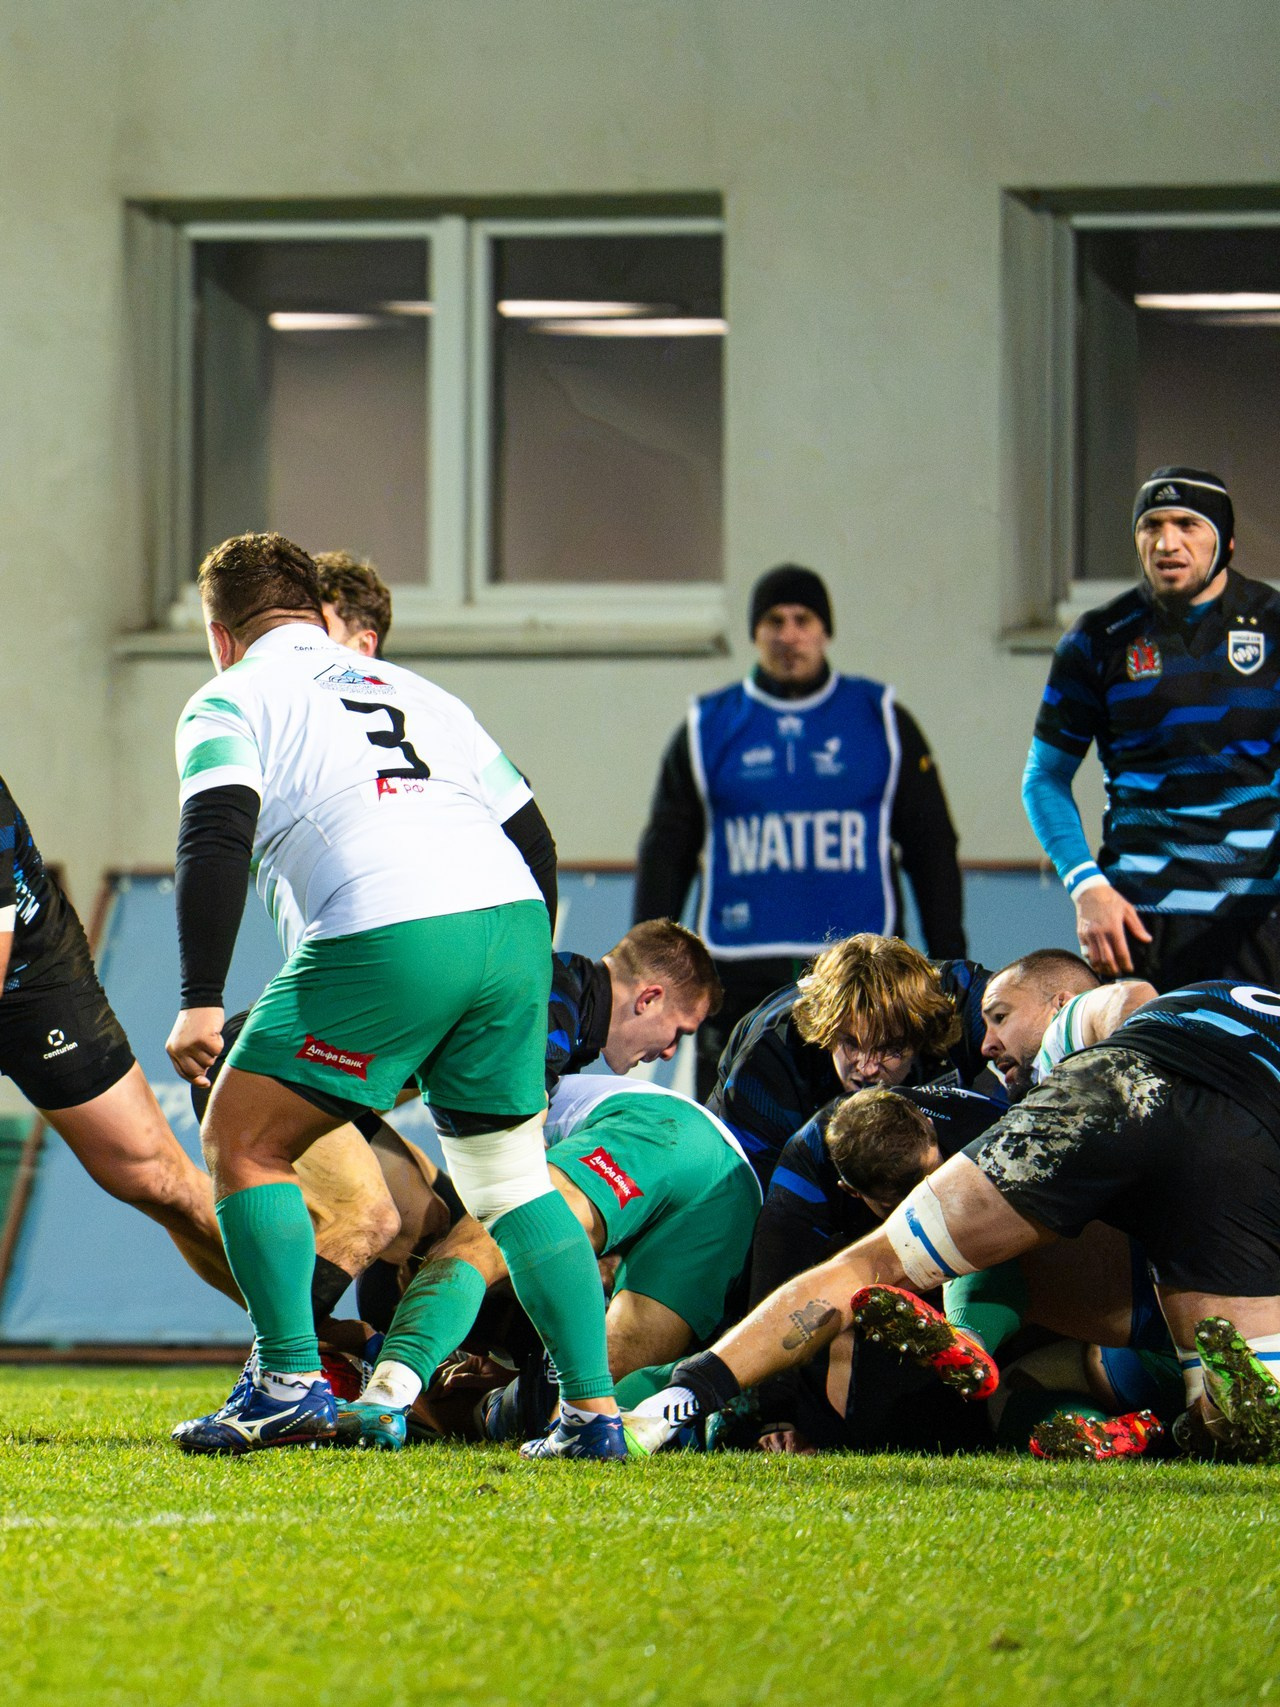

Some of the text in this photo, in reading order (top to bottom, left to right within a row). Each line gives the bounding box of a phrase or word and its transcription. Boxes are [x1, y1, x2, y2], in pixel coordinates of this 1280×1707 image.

[340, 698, 431, 780] 3
[725, 810, 866, 876] WATER
[43, 1041, 78, 1060] centurion
[306, 1044, 363, 1069] Альфа Банк
[590, 1155, 631, 1197] Альфа Банк
